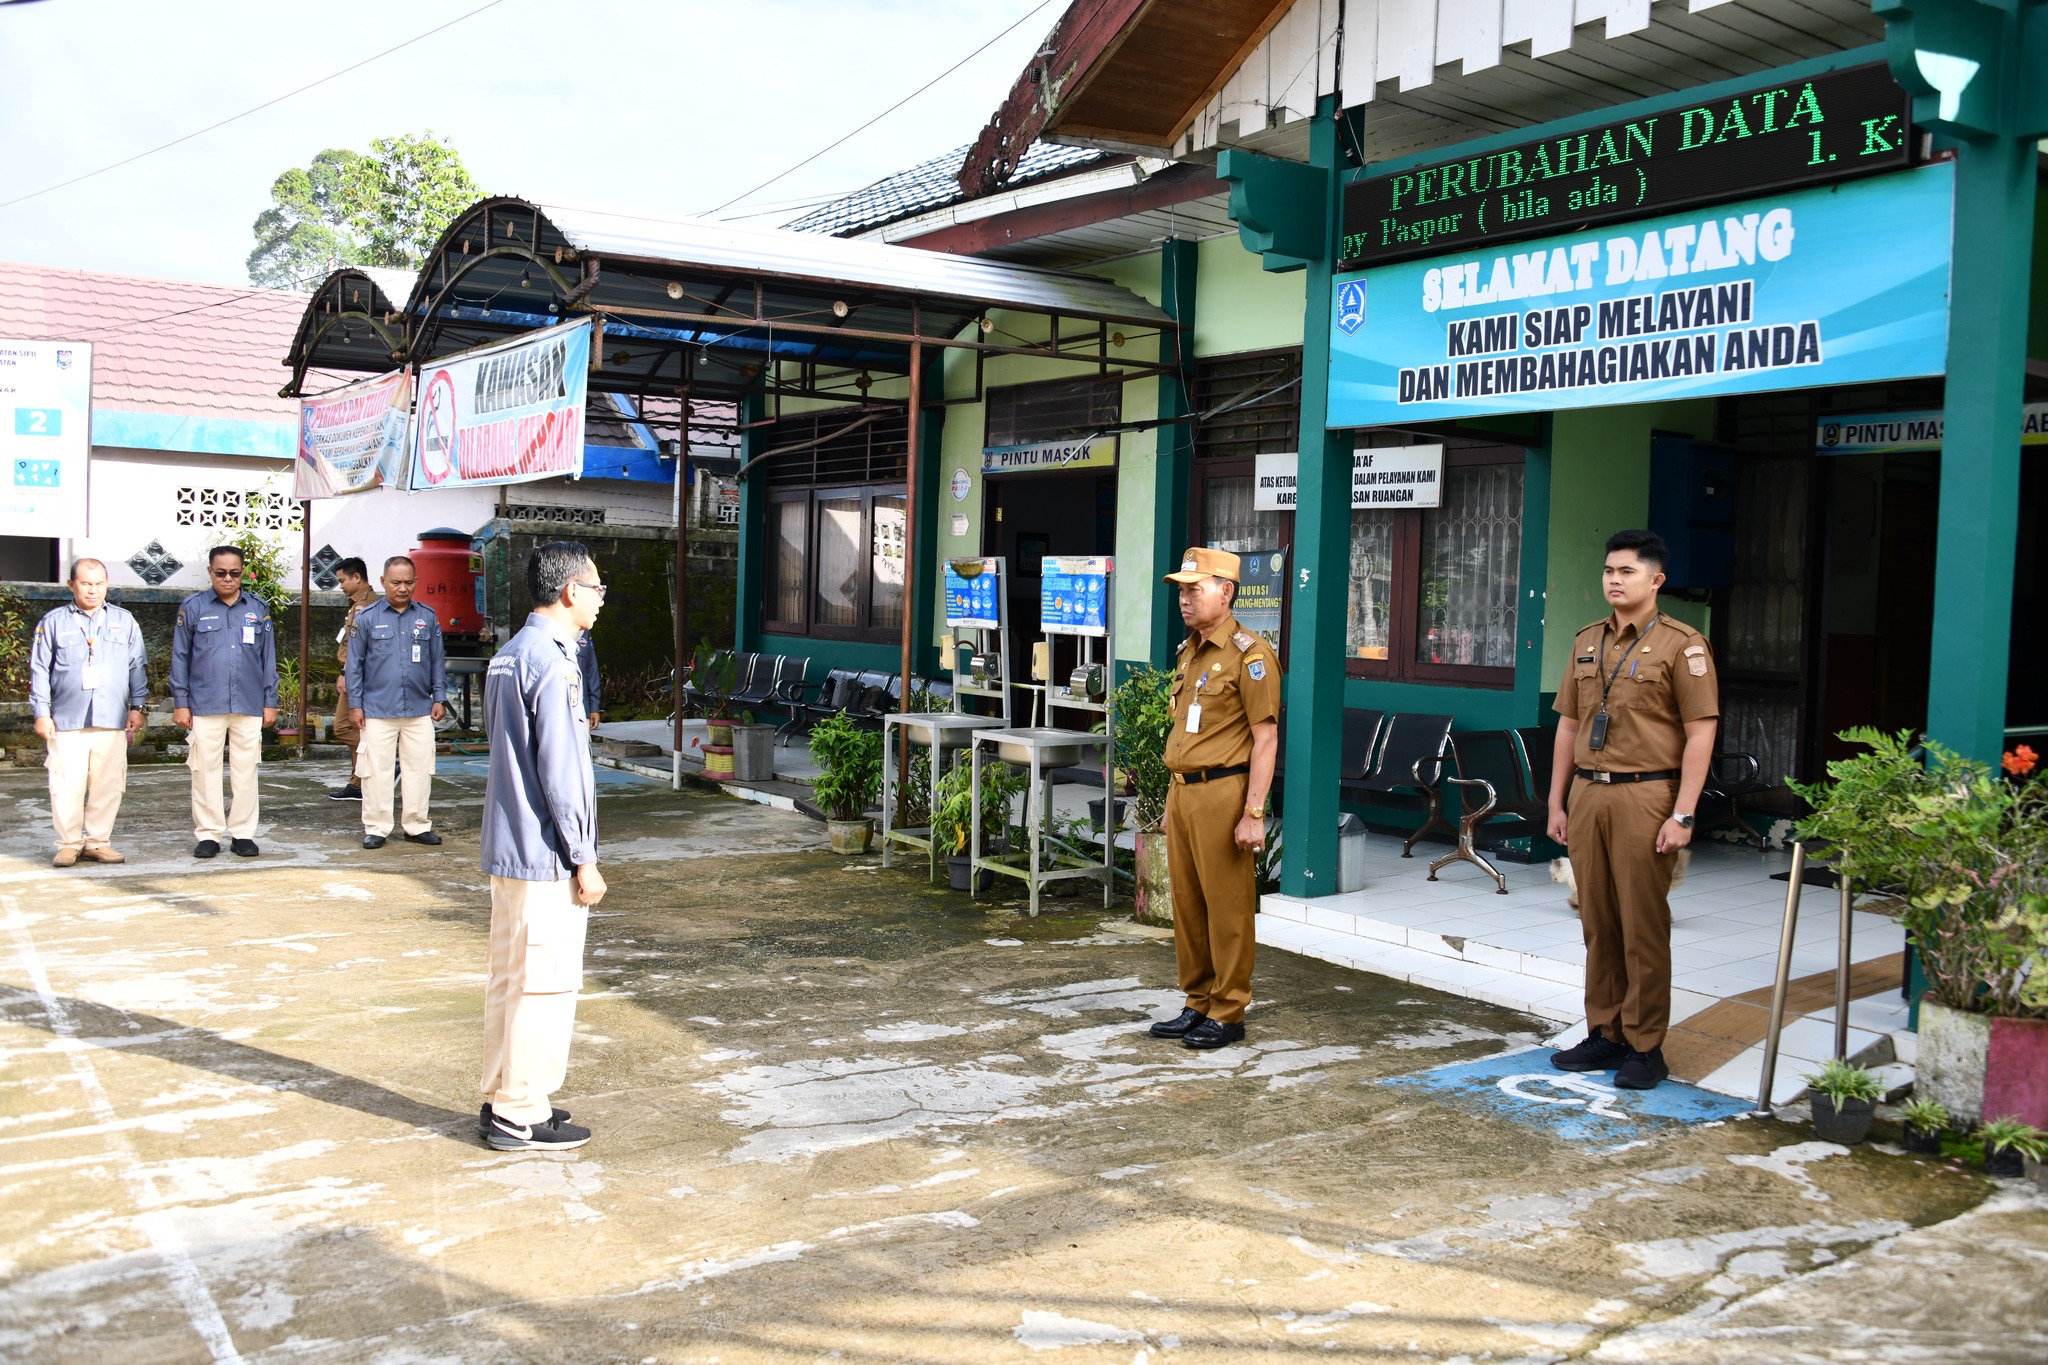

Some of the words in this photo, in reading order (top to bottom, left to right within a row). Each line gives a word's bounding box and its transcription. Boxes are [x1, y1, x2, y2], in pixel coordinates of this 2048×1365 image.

[1389, 118, 1658, 212] PERUBAHAN
[1678, 82, 1825, 151] DATA
[1381, 213, 1463, 245] Paspor
[1502, 190, 1549, 223] bila
[1568, 176, 1618, 210] ada
[1808, 130, 1837, 165] 1.
[1860, 115, 1902, 155] K
[1422, 241, 1600, 312] SELAMAT
[1605, 208, 1795, 286] DATANG
[1448, 314, 1518, 357] KAMI
[1524, 305, 1591, 348] SIAP
[1599, 281, 1751, 339] MELAYANI
[1399, 365, 1450, 403] DAN
[1456, 334, 1716, 398] MEMBAHAGIAKAN
[1723, 322, 1820, 372] ANDA
[474, 338, 567, 415] KAWASAN
[29, 411, 48, 432] 2
[311, 402, 346, 428] PERIKSA
[1845, 423, 1902, 444] PINTU
[458, 419, 518, 480] DILARANG
[1001, 449, 1038, 466] PINTU
[1042, 446, 1091, 463] MASUK
[1353, 455, 1374, 468] A'AF
[1260, 476, 1274, 489] ATAS
[1275, 476, 1297, 488] KETIDA
[1354, 472, 1376, 486] DALAM
[1378, 471, 1416, 485] PELAYANAN
[1417, 470, 1436, 483] KAMI
[1277, 492, 1297, 505] KARE
[1351, 491, 1370, 503] SAN
[1372, 489, 1414, 503] RUANGAN
[1238, 585, 1269, 596] INOVASI
[1233, 597, 1282, 609] NTANG-MENTANG"
